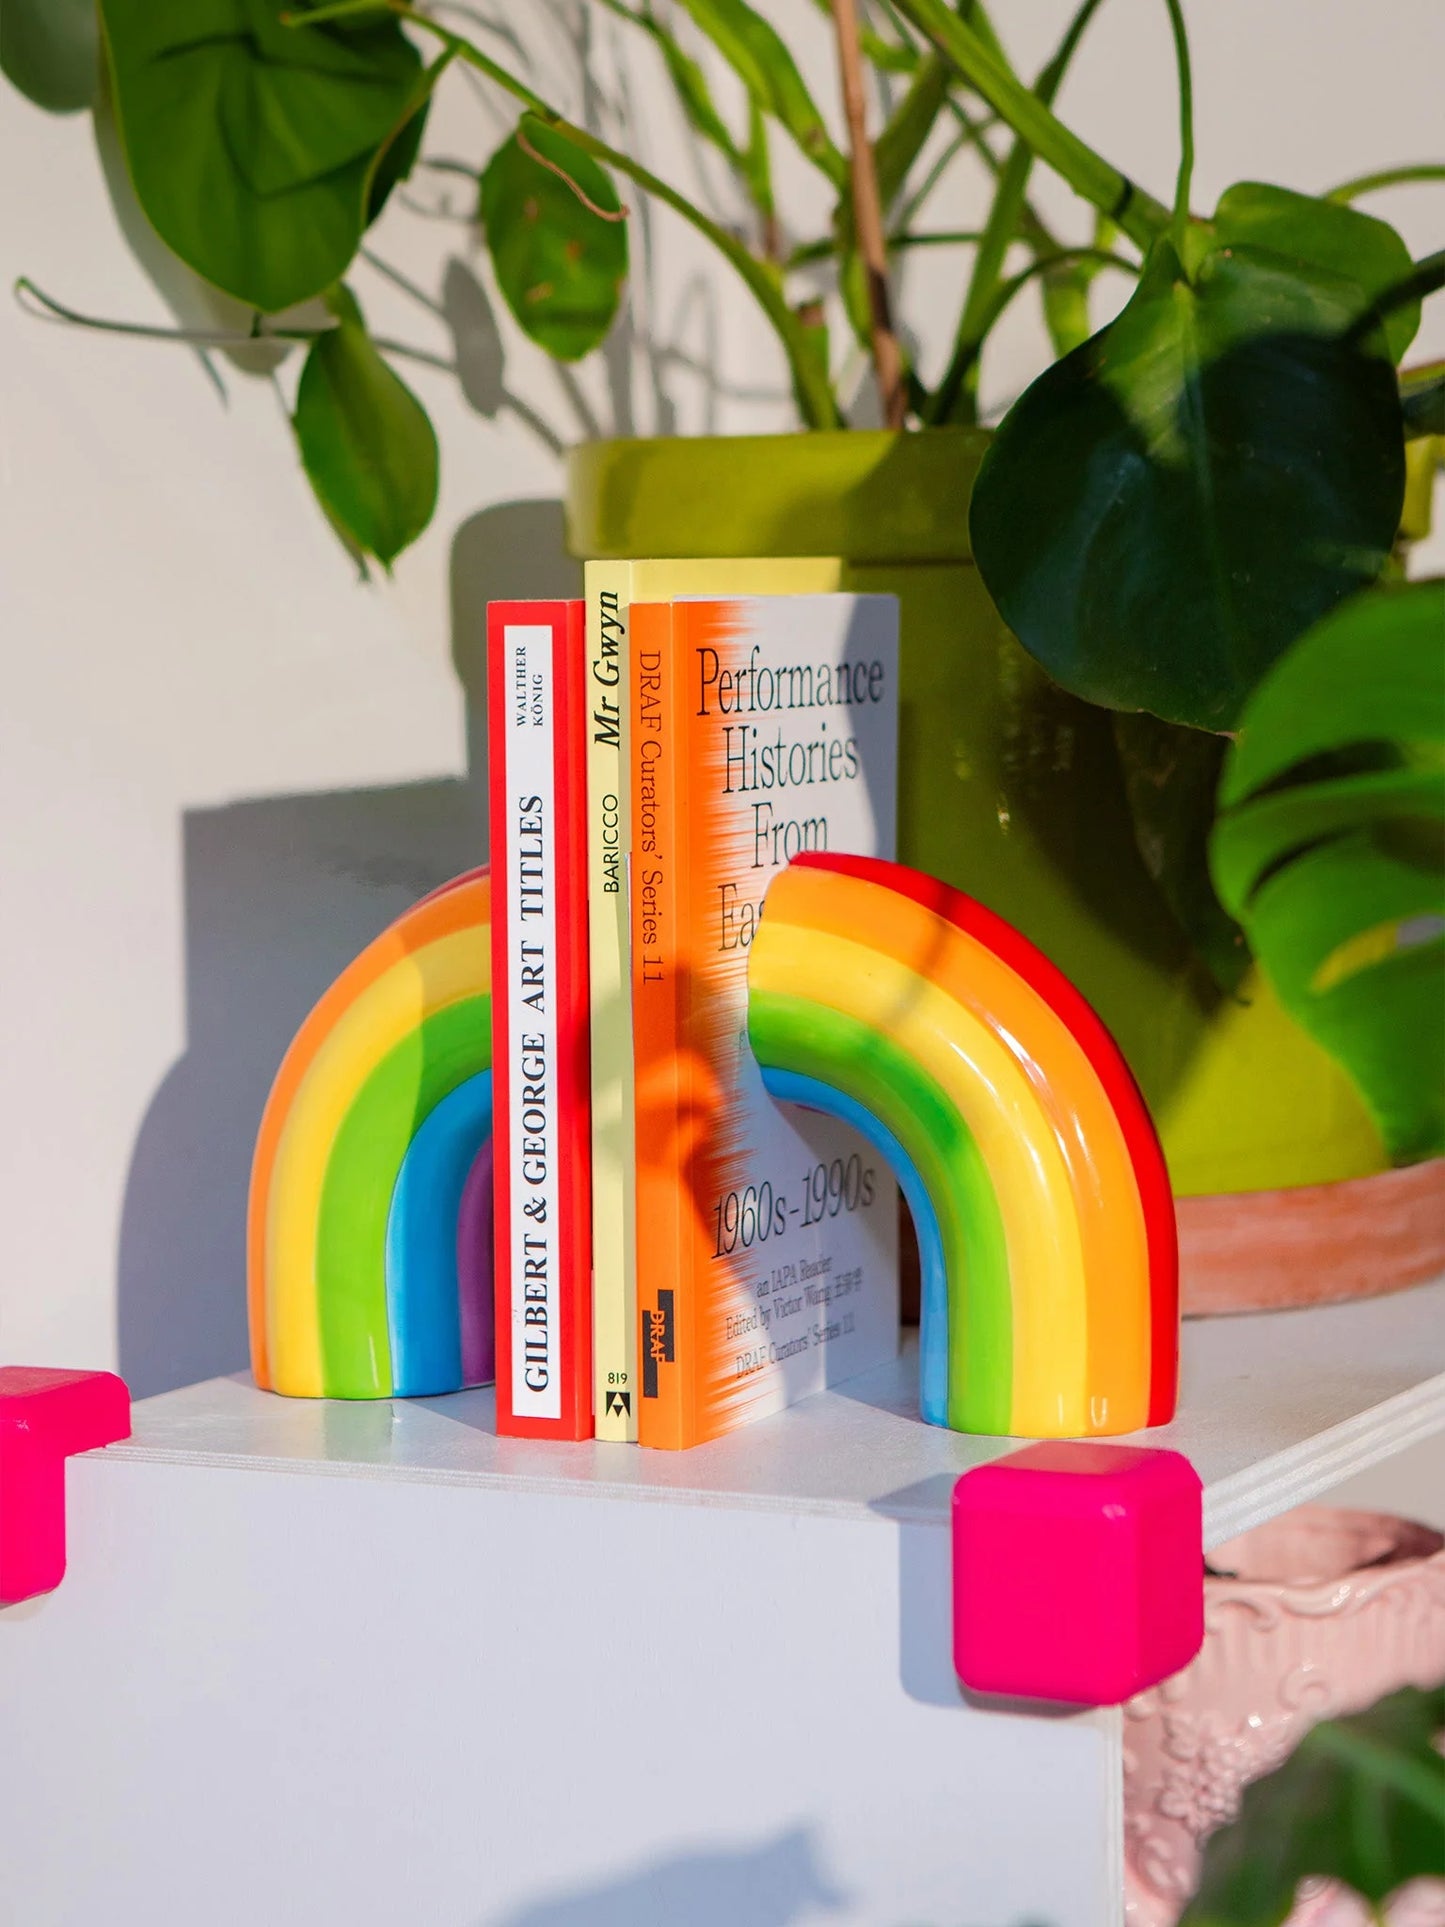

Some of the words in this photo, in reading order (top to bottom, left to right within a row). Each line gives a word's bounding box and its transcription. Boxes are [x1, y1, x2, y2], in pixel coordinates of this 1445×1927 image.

[593, 591, 625, 687] Gwyn
[515, 646, 527, 727] WALTHER
[530, 674, 543, 727] KÖNIG
[640, 650, 662, 732] DRAF
[696, 645, 885, 716] Performance
[594, 696, 621, 750] Mr
[722, 722, 859, 794] Histories
[519, 795, 544, 922] TITLES
[602, 794, 619, 893] BARICCO
[751, 802, 828, 869] From
[642, 870, 664, 945] Series
[521, 940, 545, 1014] ART
[643, 955, 665, 985] 11
[522, 1033, 547, 1186] GEORGE
[523, 1197, 547, 1224] &
[524, 1233, 549, 1393] GILBERT
[726, 1307, 758, 1340] Edited
[760, 1304, 771, 1331] by
[773, 1297, 803, 1319] Victor
[756, 1280, 769, 1298] an
[650, 1310, 666, 1363] DRAF
[736, 1345, 767, 1379] DRAF
[813, 1321, 841, 1346] Series
[607, 1372, 628, 1385] 819
